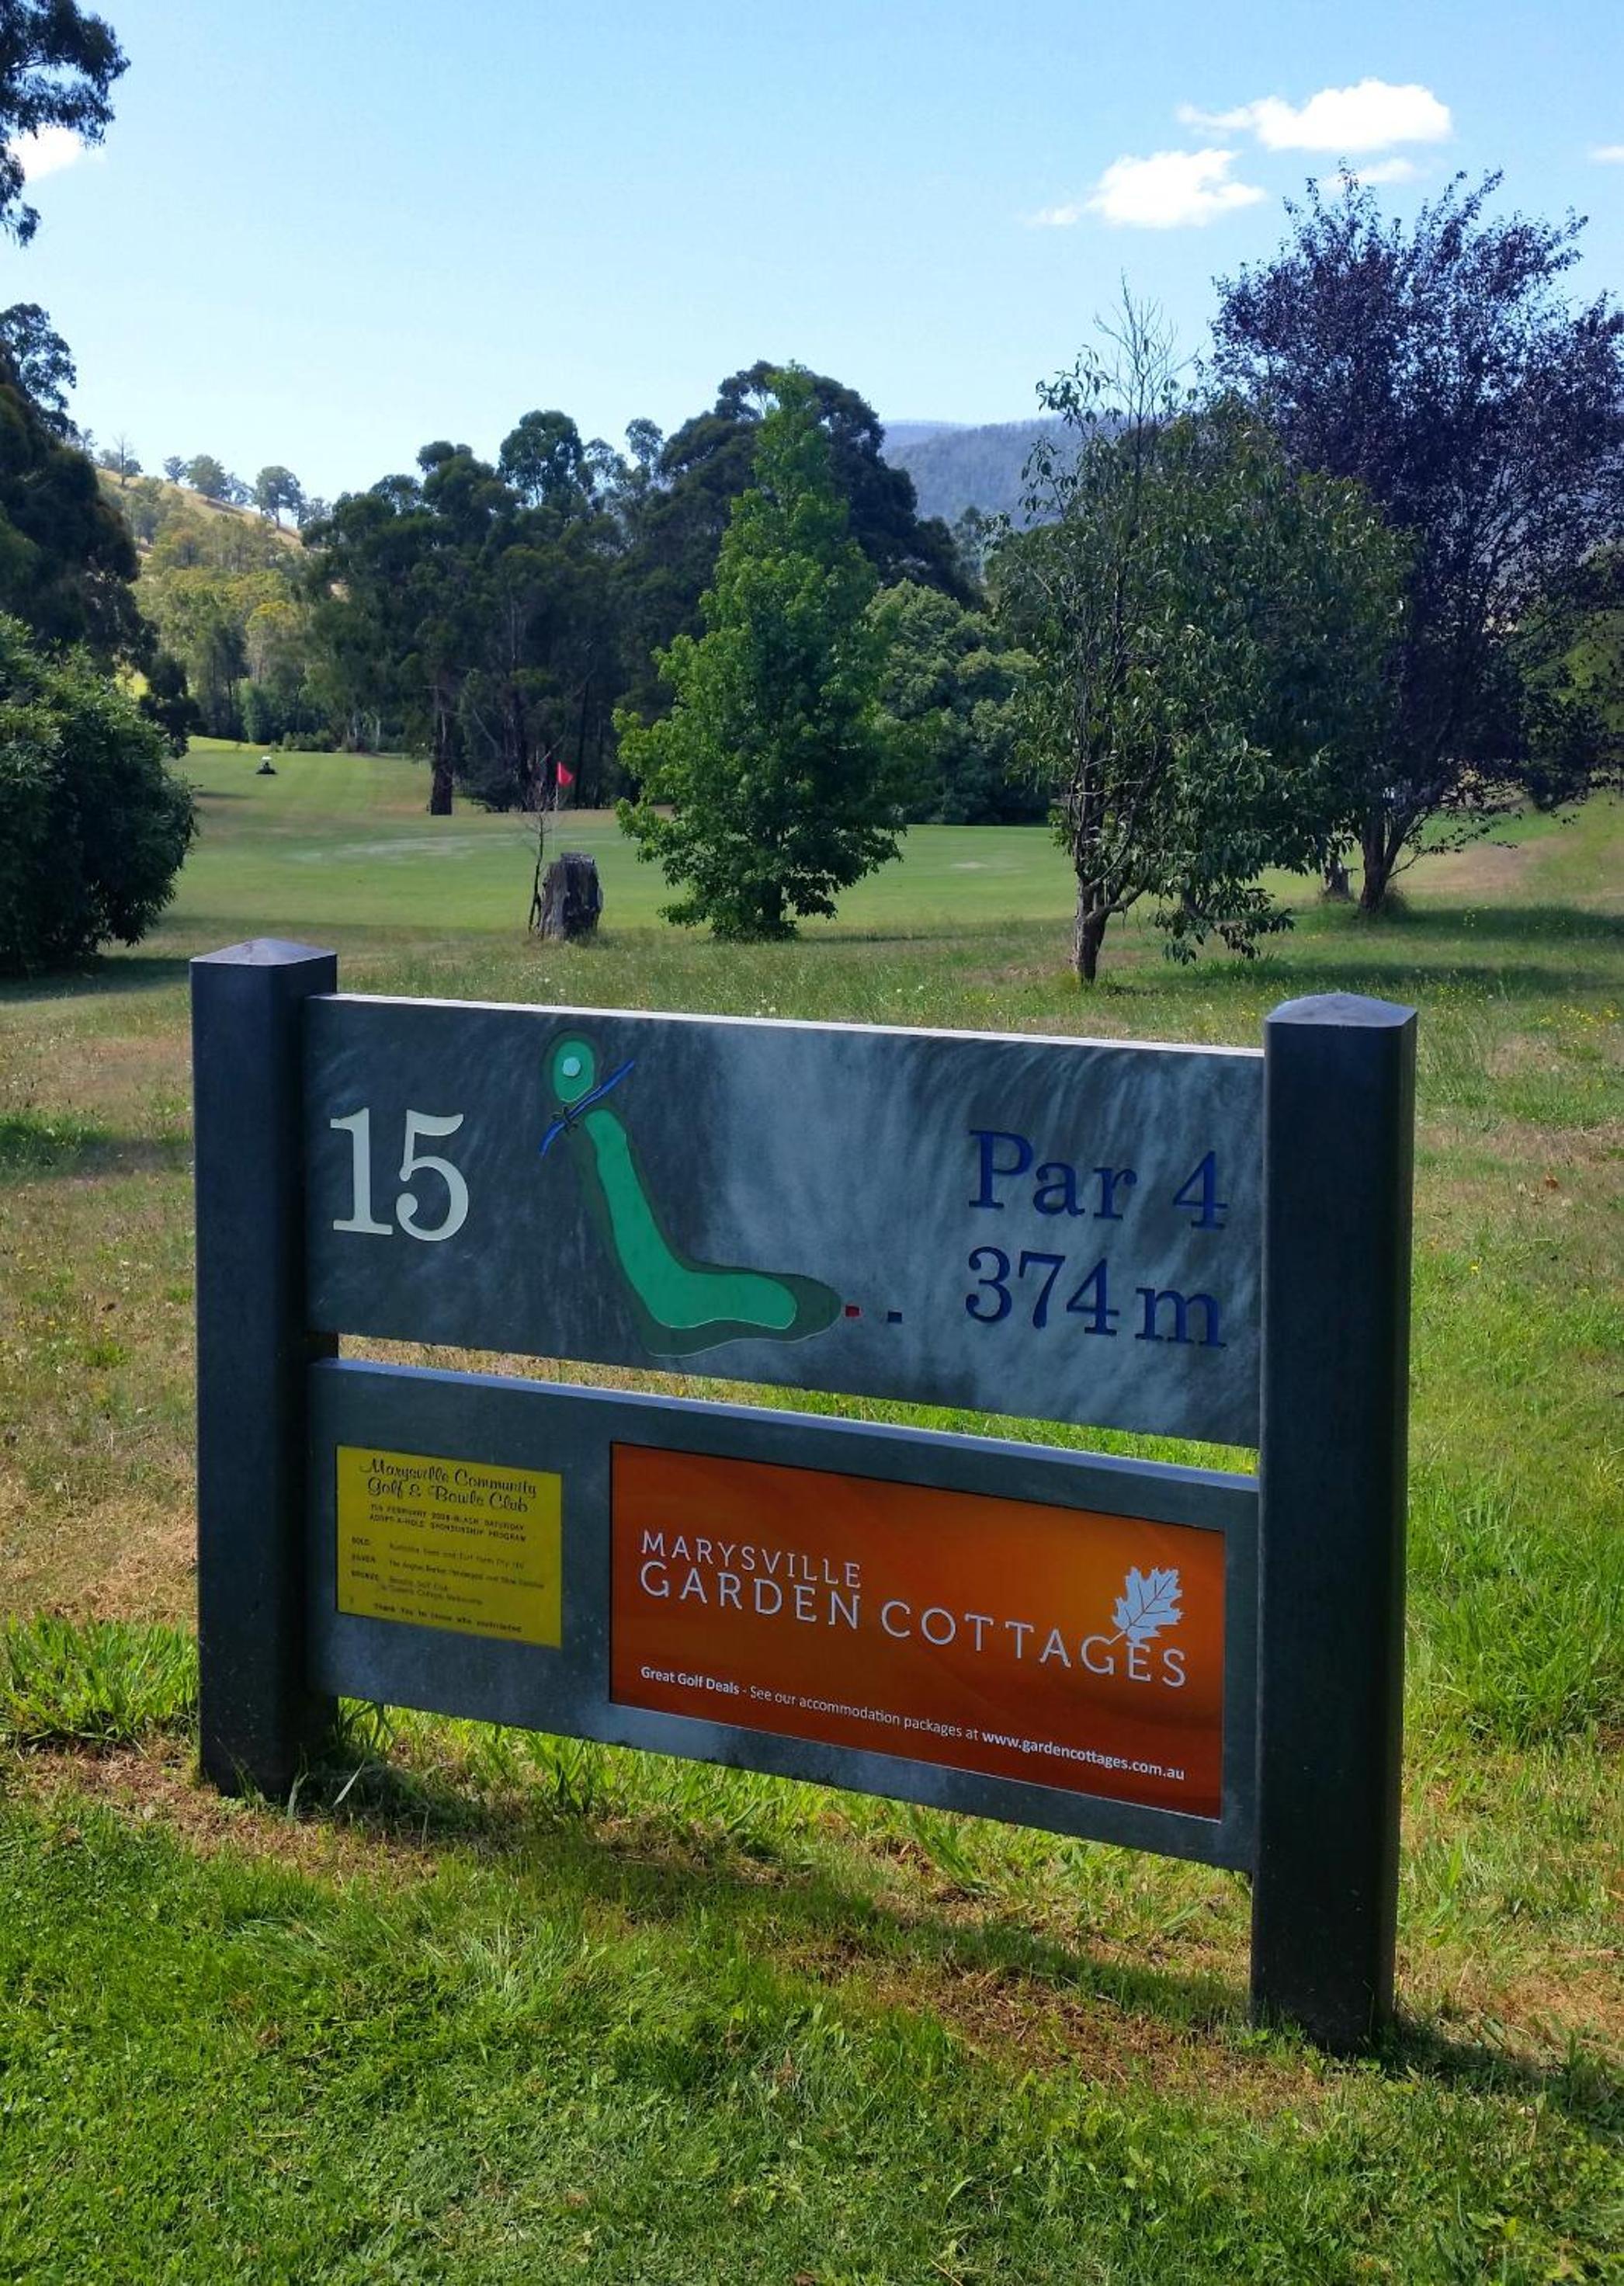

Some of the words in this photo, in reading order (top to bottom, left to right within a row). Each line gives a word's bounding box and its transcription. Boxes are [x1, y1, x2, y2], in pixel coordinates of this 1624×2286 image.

[330, 1107, 468, 1242] 15
[968, 1130, 1136, 1220] Par
[1172, 1151, 1227, 1230] 4
[369, 1476, 402, 1498] Golf
[409, 1484, 422, 1497] &
[429, 1485, 484, 1506] Bowls
[489, 1492, 528, 1513] Club
[455, 1468, 536, 1499] Community
[488, 1530, 526, 1542] PROGRAM
[641, 1529, 862, 1589] MARYSVILLE
[640, 1561, 860, 1630] GARDEN
[880, 1600, 1186, 1688] COTTAGES
[641, 1666, 675, 1683] Great
[678, 1673, 703, 1688] Golf
[706, 1679, 739, 1696] Deals
[750, 1685, 772, 1701] See
[775, 1693, 796, 1705] our
[800, 1695, 900, 1726] accommodation
[904, 1714, 962, 1738] packages
[966, 1728, 979, 1741] at
[982, 1730, 1185, 1781] www.gardencottages.com.au
